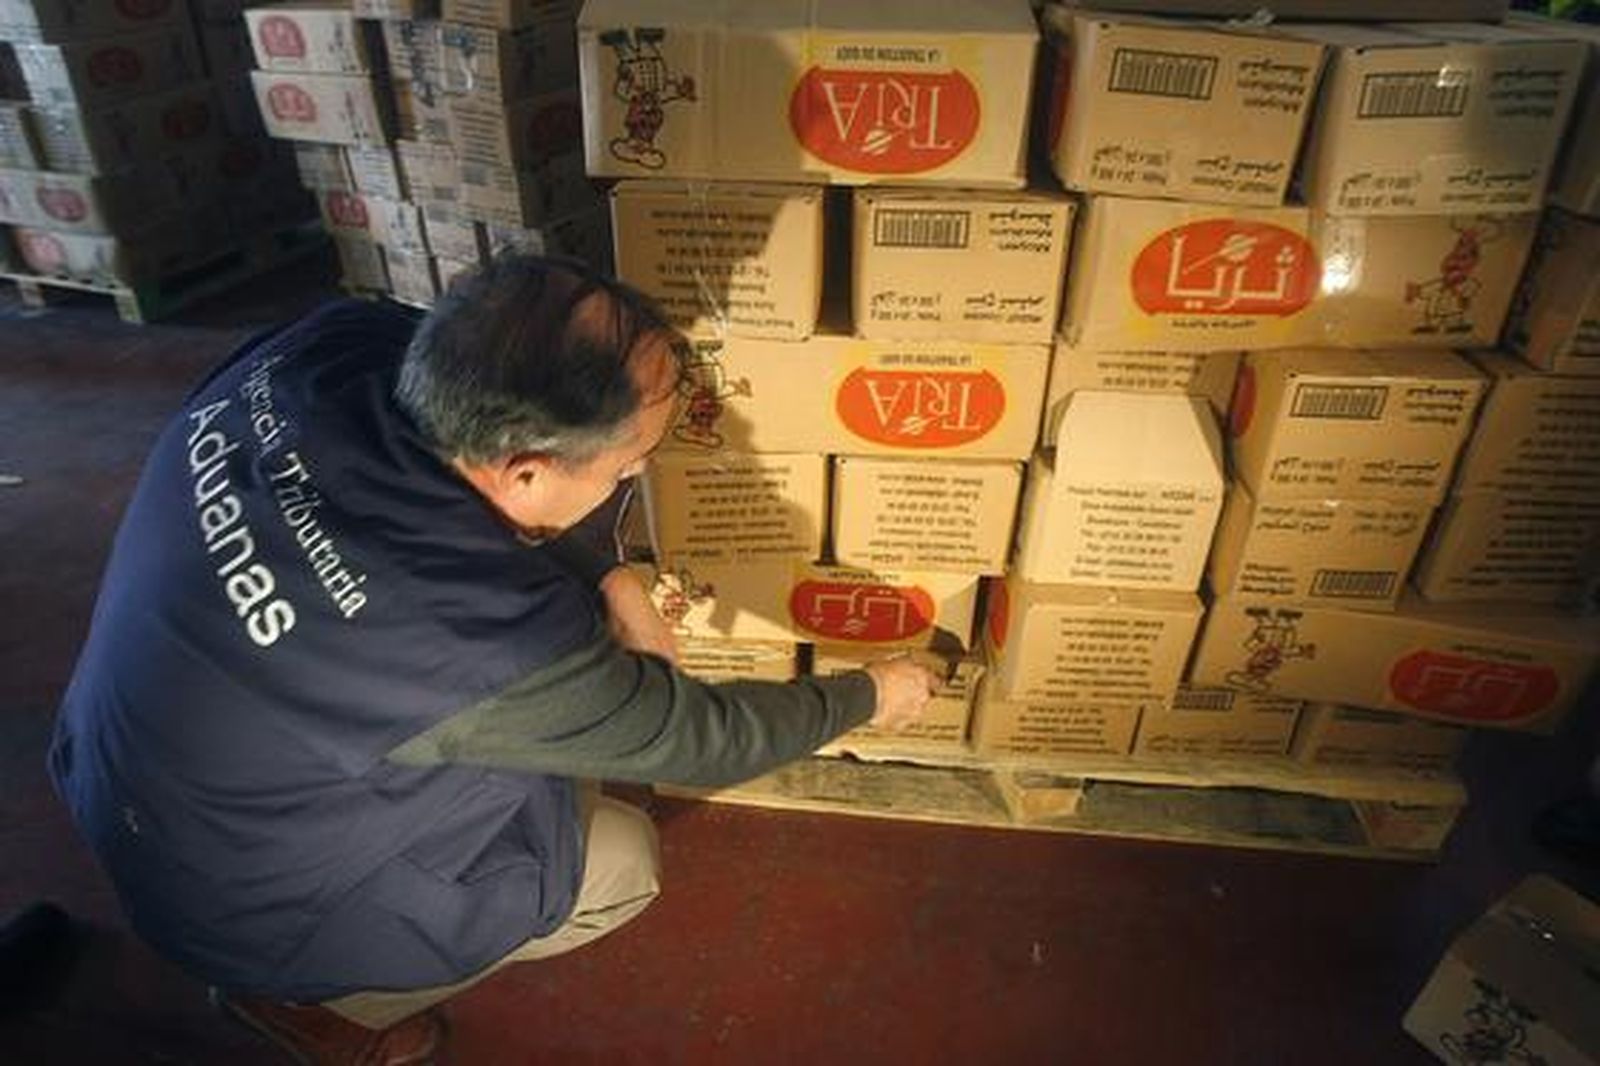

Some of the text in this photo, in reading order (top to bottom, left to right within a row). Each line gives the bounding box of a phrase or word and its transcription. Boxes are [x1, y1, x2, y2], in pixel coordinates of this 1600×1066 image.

[823, 78, 957, 150] TRIA
[866, 377, 981, 430] TRIA
[187, 399, 297, 648] Aduanas
[270, 452, 368, 618] Tributaria
